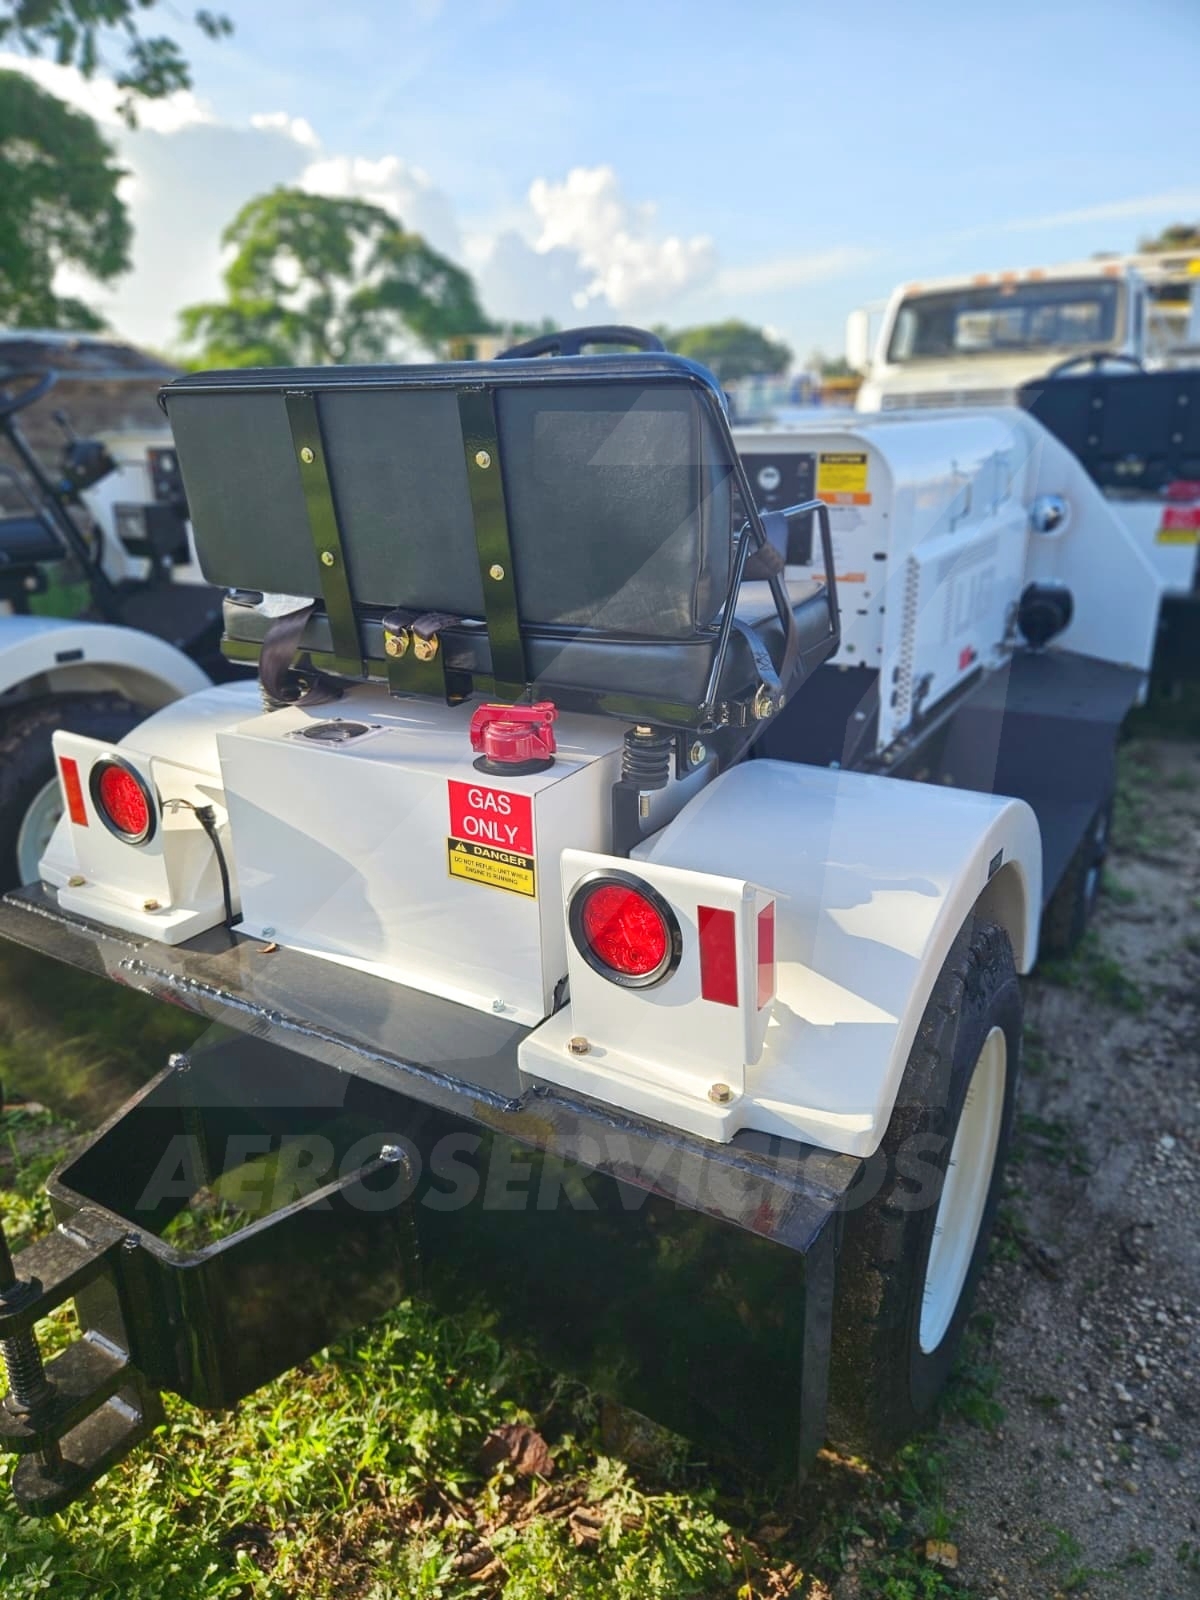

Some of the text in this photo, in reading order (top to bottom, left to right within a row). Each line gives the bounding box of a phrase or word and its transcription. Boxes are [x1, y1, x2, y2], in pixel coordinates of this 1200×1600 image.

[468, 789, 511, 815] GAS
[463, 816, 518, 844] ONLY
[473, 846, 527, 867] DANGER
[465, 866, 485, 876] ENGINE
[493, 873, 518, 885] RUNNING
[475, 862, 497, 873] REFUEL
[497, 867, 510, 875] UNIT
[510, 870, 529, 881] WHILE
